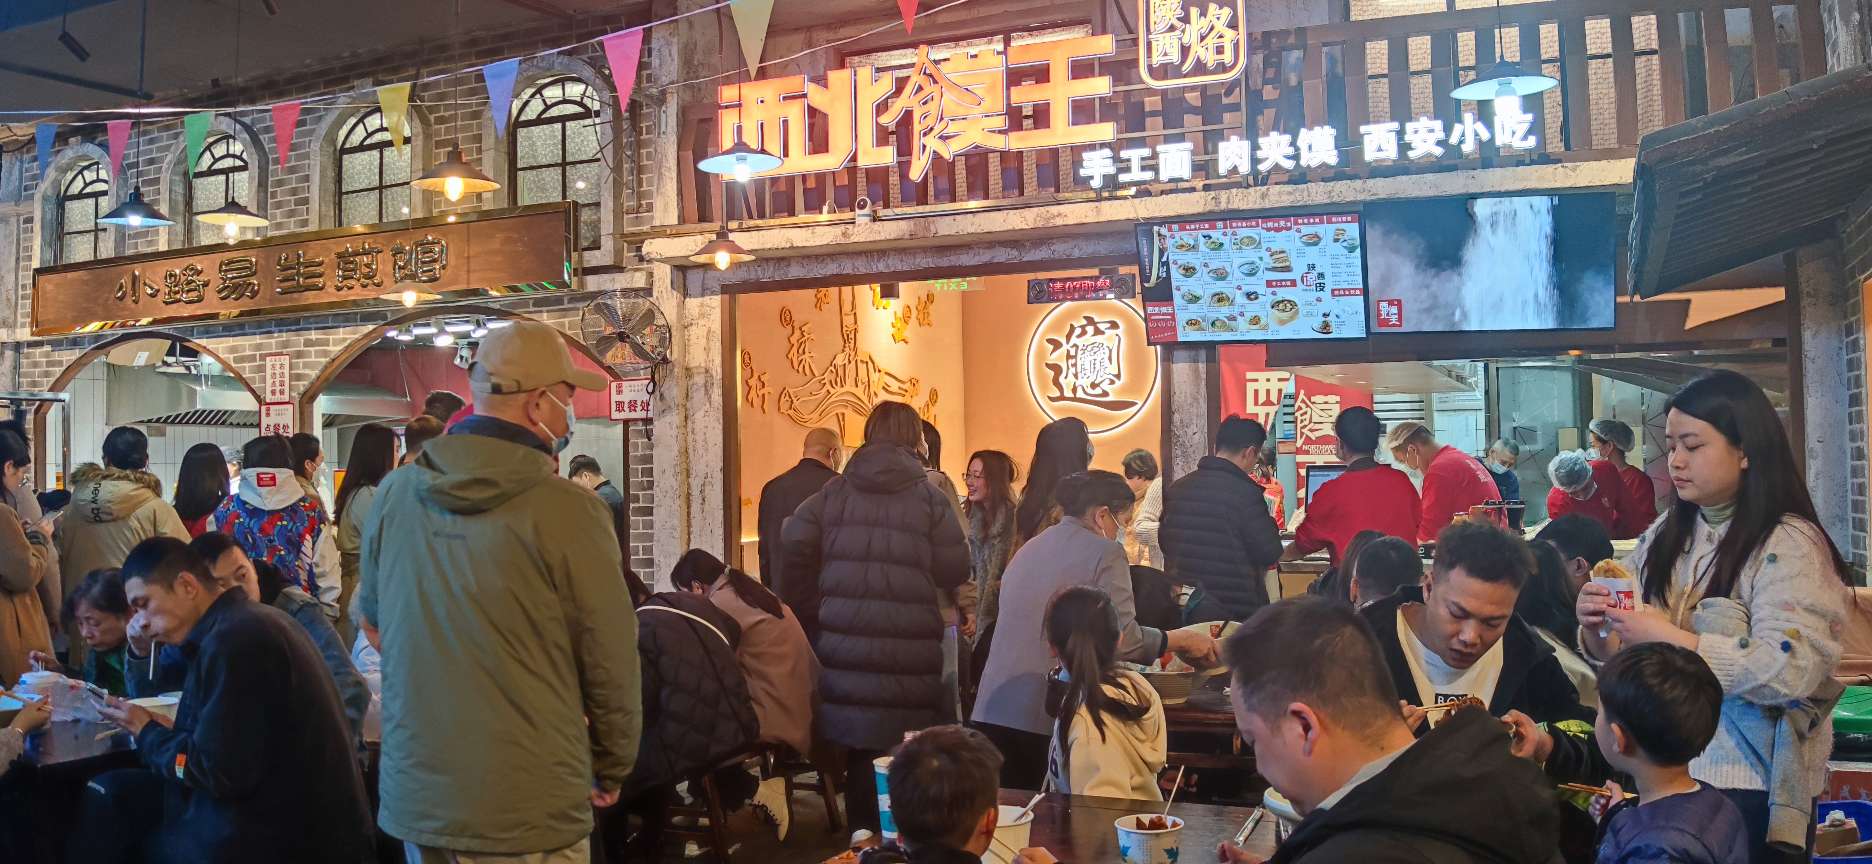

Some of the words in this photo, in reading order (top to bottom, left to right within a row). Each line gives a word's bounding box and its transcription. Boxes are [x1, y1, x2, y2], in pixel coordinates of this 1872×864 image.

[1181, 2, 1239, 73] 烙
[1079, 142, 1194, 190] 手工面
[1217, 125, 1340, 176] 肉夹馍
[1359, 108, 1537, 162] 西安小吃
[614, 399, 651, 414] 取餐处
[264, 423, 290, 434] 点餐处
